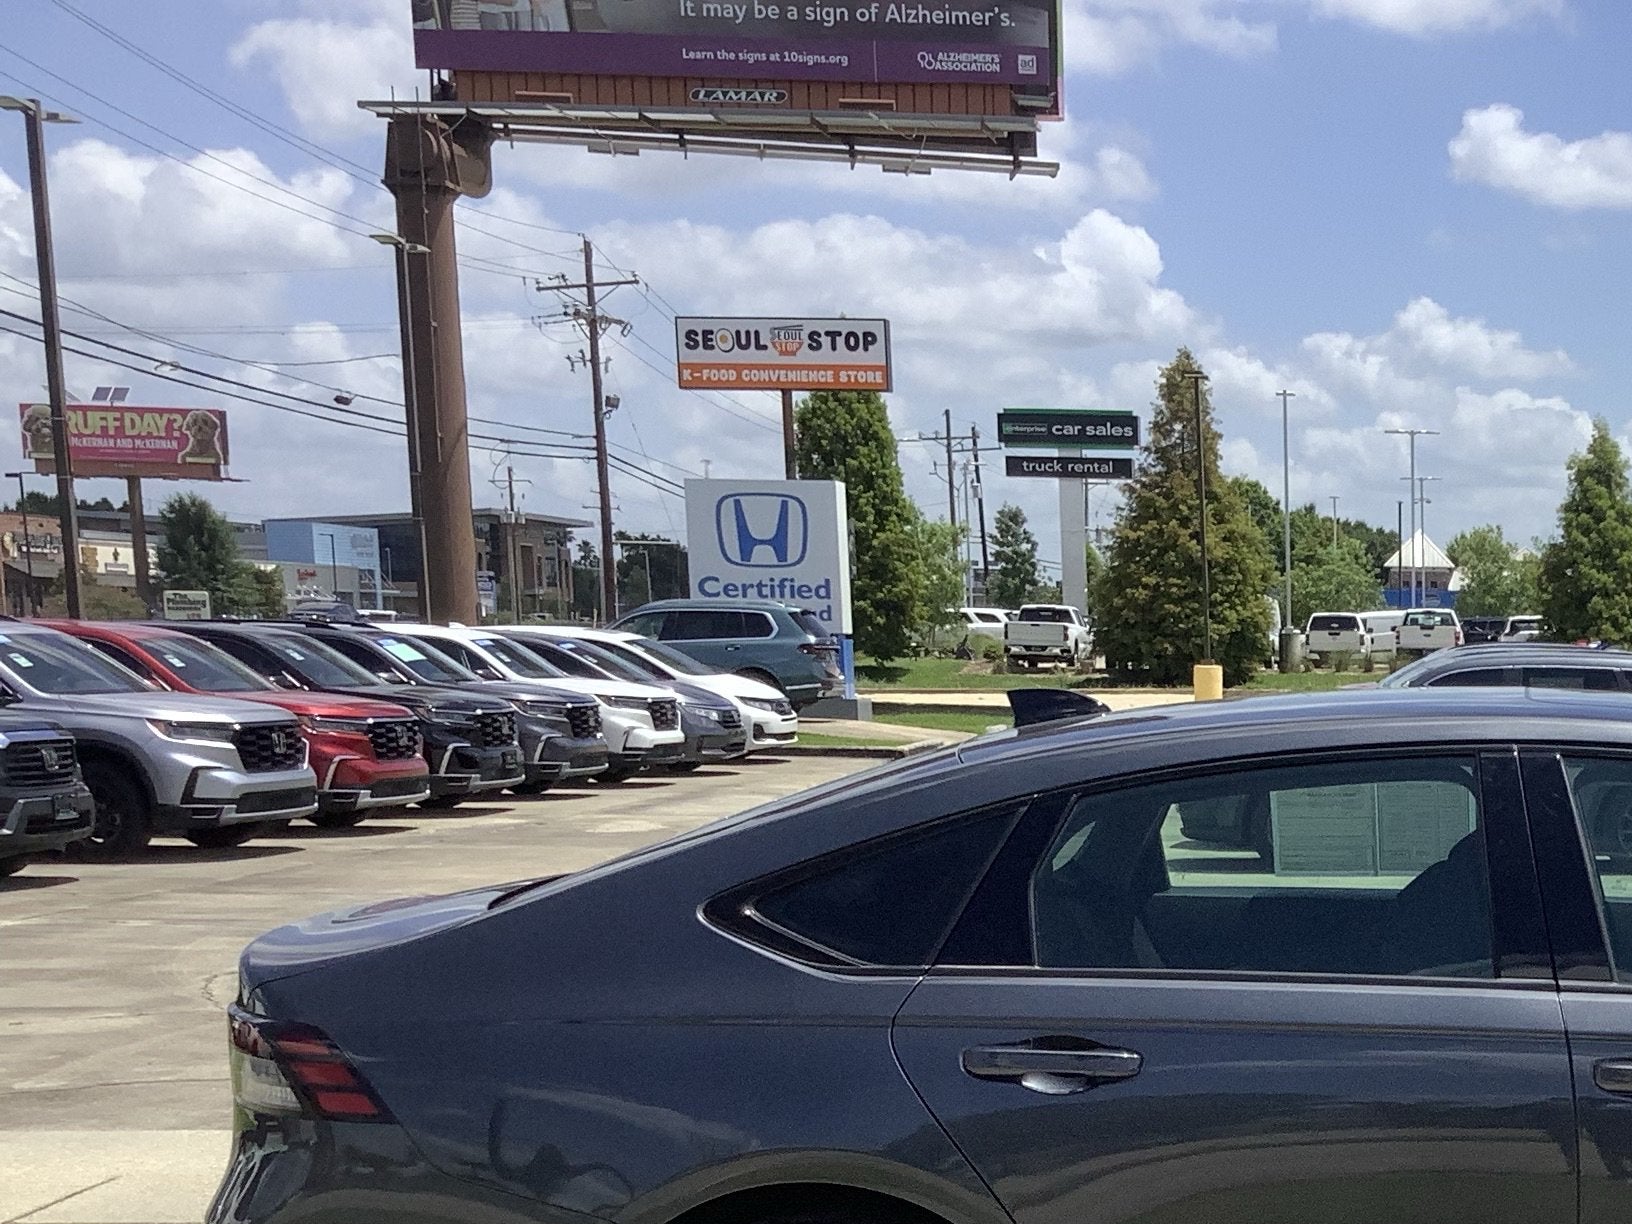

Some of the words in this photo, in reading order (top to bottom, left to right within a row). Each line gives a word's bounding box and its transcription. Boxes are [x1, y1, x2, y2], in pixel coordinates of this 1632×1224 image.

[680, 0, 696, 17] It
[702, 2, 747, 24] may
[754, 0, 780, 19] be
[787, 5, 798, 20] a
[805, 1, 849, 26] sign
[855, 4, 880, 22] of
[885, 3, 1016, 27] Alzheimer's.
[682, 48, 714, 60] Learn
[716, 50, 736, 60] the
[738, 50, 767, 63] signs
[769, 52, 781, 62] at
[783, 52, 849, 66] 10signs.org
[934, 61, 1000, 73] ASSOCIATION
[698, 89, 778, 102] LAMAR
[684, 328, 769, 353] SEOUL
[807, 330, 878, 352] STOP
[741, 370, 834, 383] CONVENIENCE
[839, 371, 884, 384] STORE
[66, 410, 120, 435] RUFF
[124, 411, 183, 438] DAY?
[1051, 424, 1082, 436] car
[1085, 421, 1134, 437] sales
[116, 438, 133, 449] AND
[1022, 459, 1063, 473] truck
[1067, 460, 1113, 474] rental
[697, 575, 832, 600] Certified
